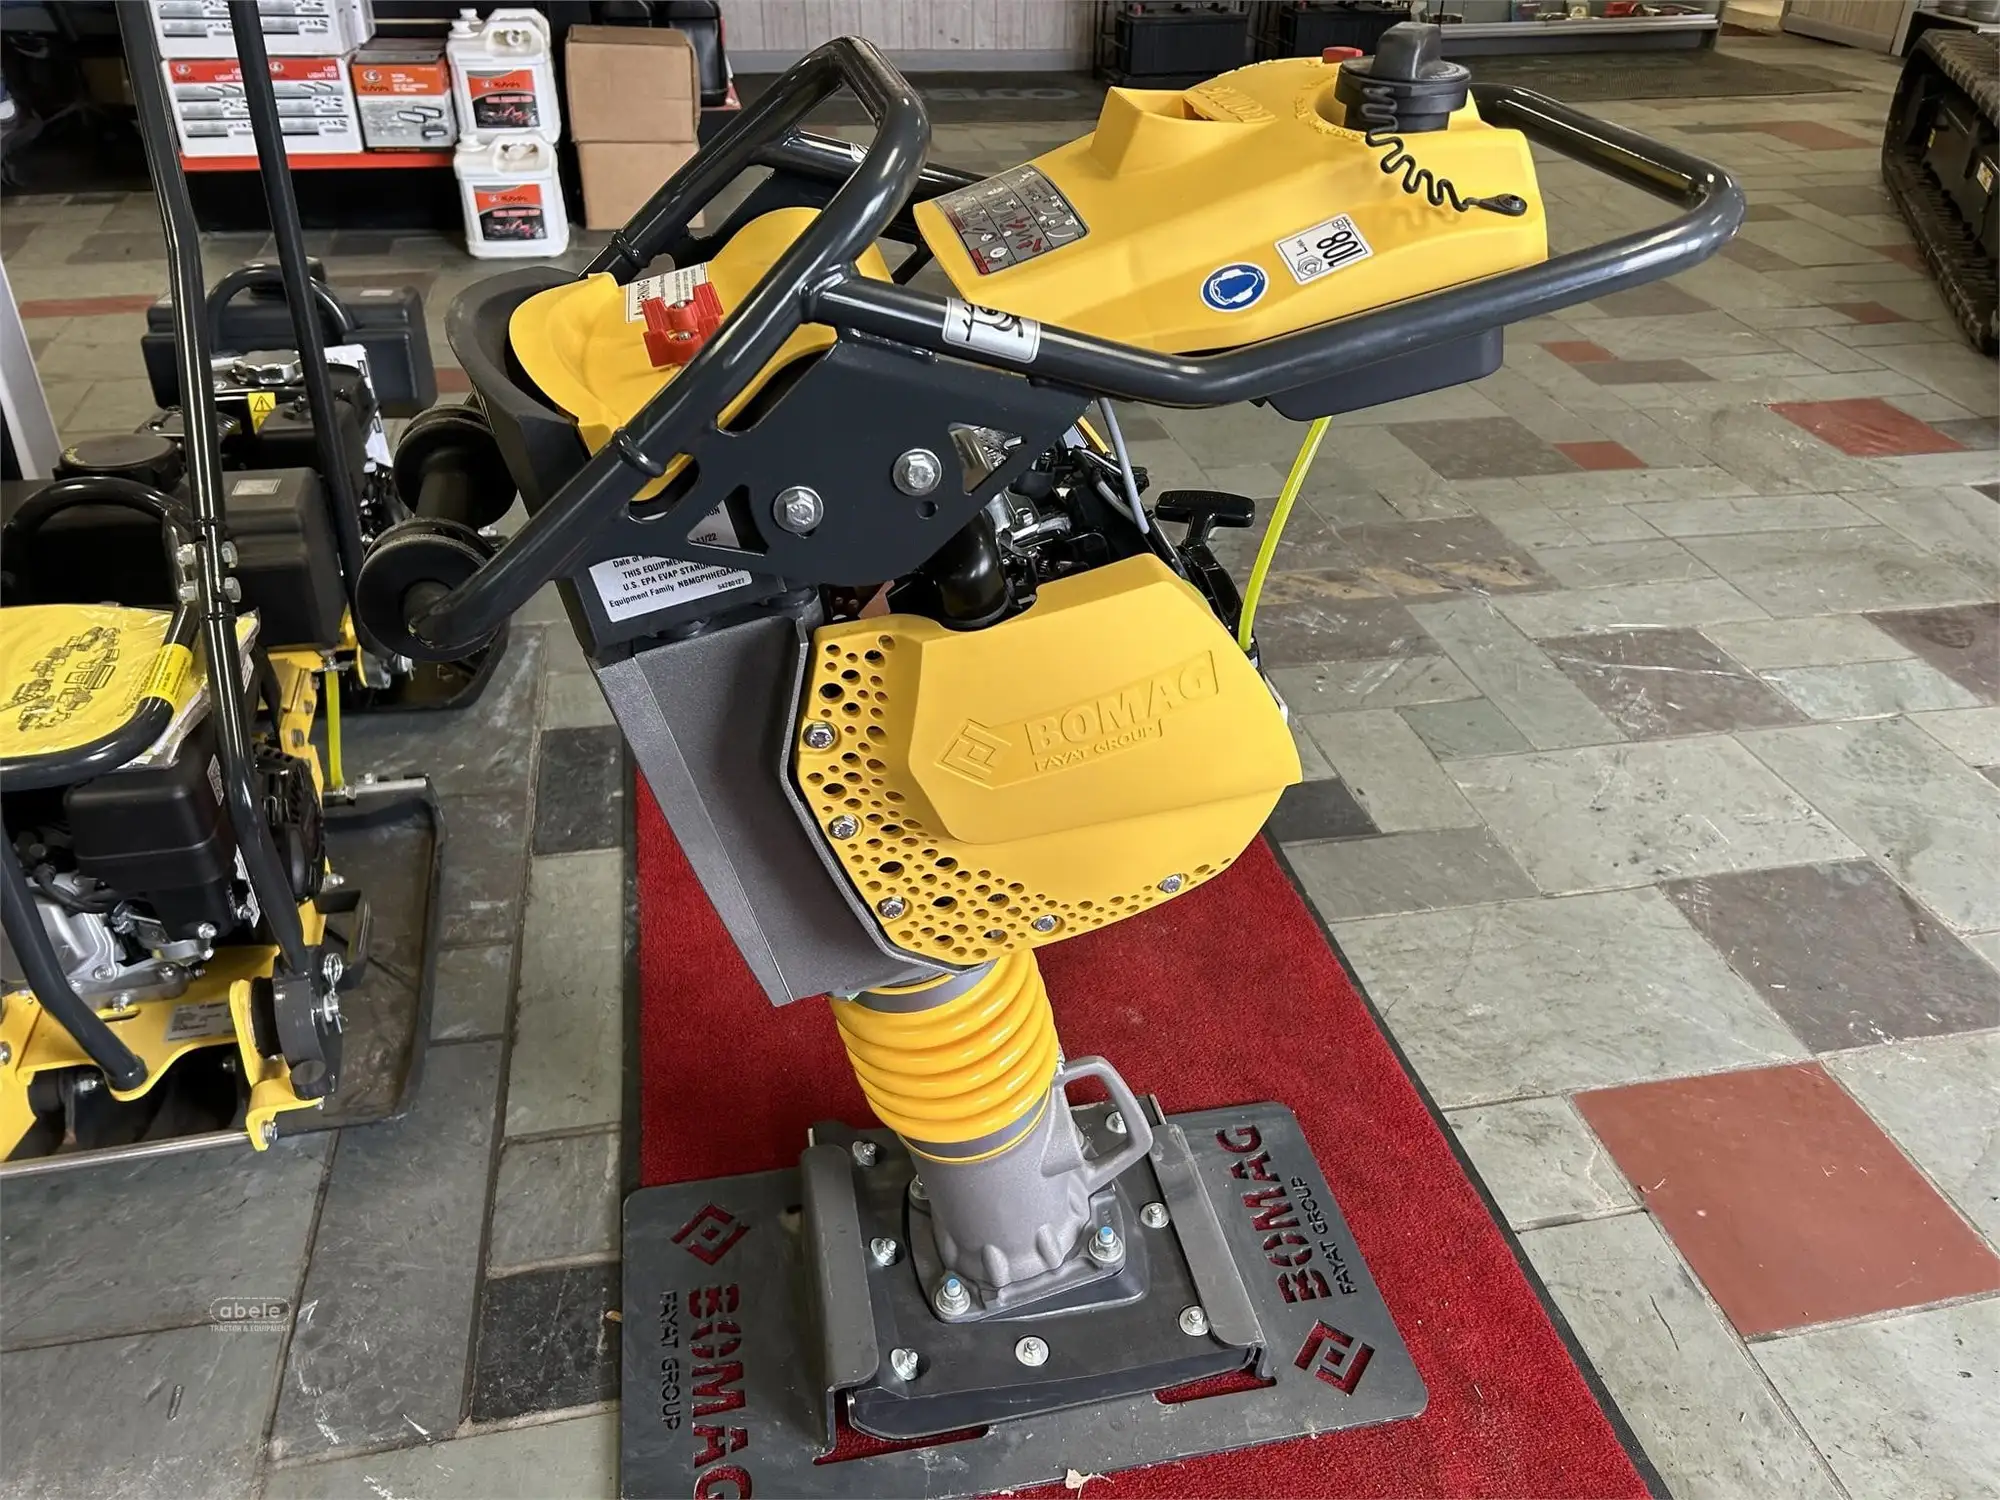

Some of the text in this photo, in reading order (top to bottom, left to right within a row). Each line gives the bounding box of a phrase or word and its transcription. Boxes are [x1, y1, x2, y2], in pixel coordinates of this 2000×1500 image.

[1316, 230, 1364, 268] 108
[612, 558, 631, 568] Date
[622, 567, 642, 579] THIS
[622, 581, 641, 592] U.S.
[640, 576, 657, 586] EPA
[658, 569, 678, 581] EVAP
[608, 591, 650, 608] Equipment
[649, 584, 675, 597] Family
[1025, 660, 1211, 756] BOMAG
[1034, 726, 1155, 772] FAYAT GROUP
[1214, 1124, 1333, 1305] BOMAG
[1289, 1175, 1359, 1296] FAYAT GROUP
[659, 1288, 681, 1432] FAYAT GROUP
[687, 1282, 754, 1500] BOMAG
